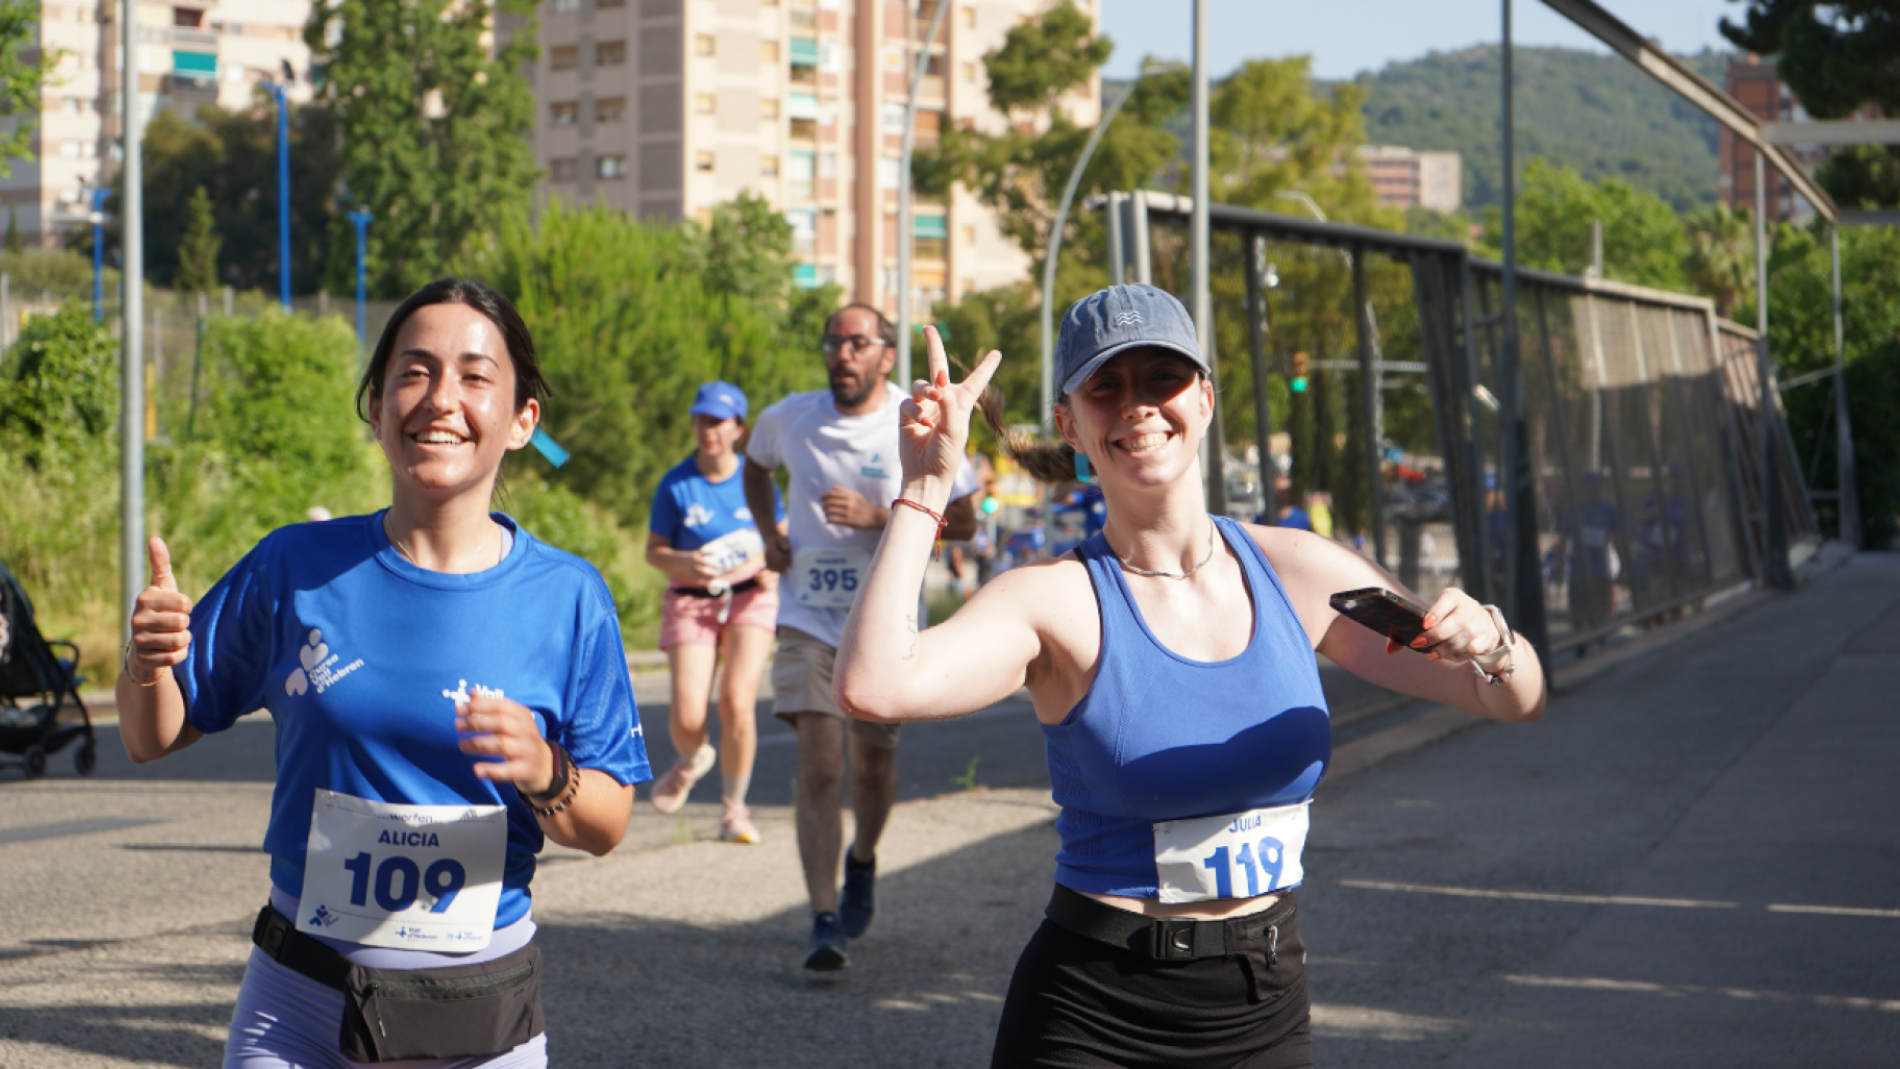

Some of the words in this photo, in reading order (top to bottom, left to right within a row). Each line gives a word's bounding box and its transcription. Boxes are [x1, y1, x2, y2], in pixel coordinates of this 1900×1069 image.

[809, 567, 858, 591] 395
[316, 658, 364, 694] d'Hebron
[389, 812, 433, 824] werfen
[1229, 815, 1261, 832] JULIA
[378, 829, 440, 847] ALICIA
[1203, 836, 1284, 899] 119
[344, 851, 466, 913] 109
